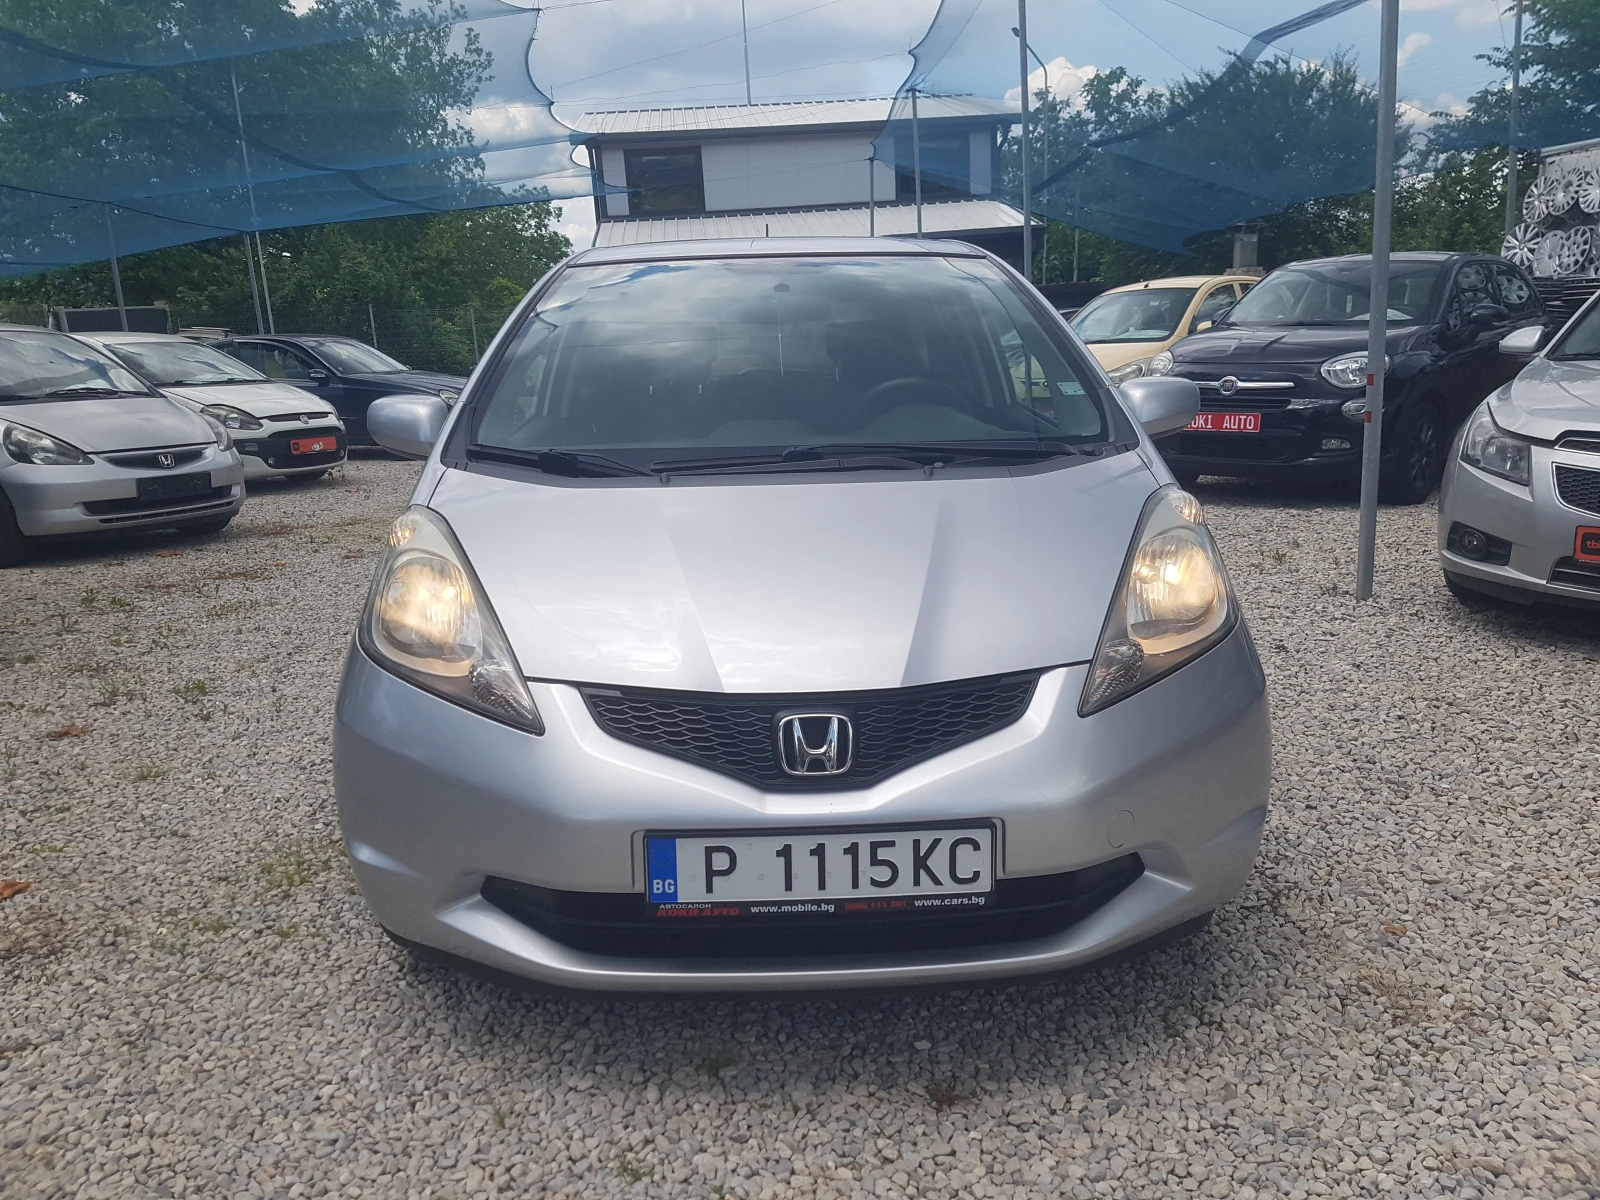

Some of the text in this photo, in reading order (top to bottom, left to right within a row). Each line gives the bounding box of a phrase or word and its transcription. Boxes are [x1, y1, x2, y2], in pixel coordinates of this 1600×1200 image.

[1187, 415, 1255, 430] OKI AUTO
[704, 845, 738, 894] P
[653, 879, 675, 894] BG
[750, 902, 836, 913] www.mobile.bg
[914, 895, 986, 907] www.cars.bg
